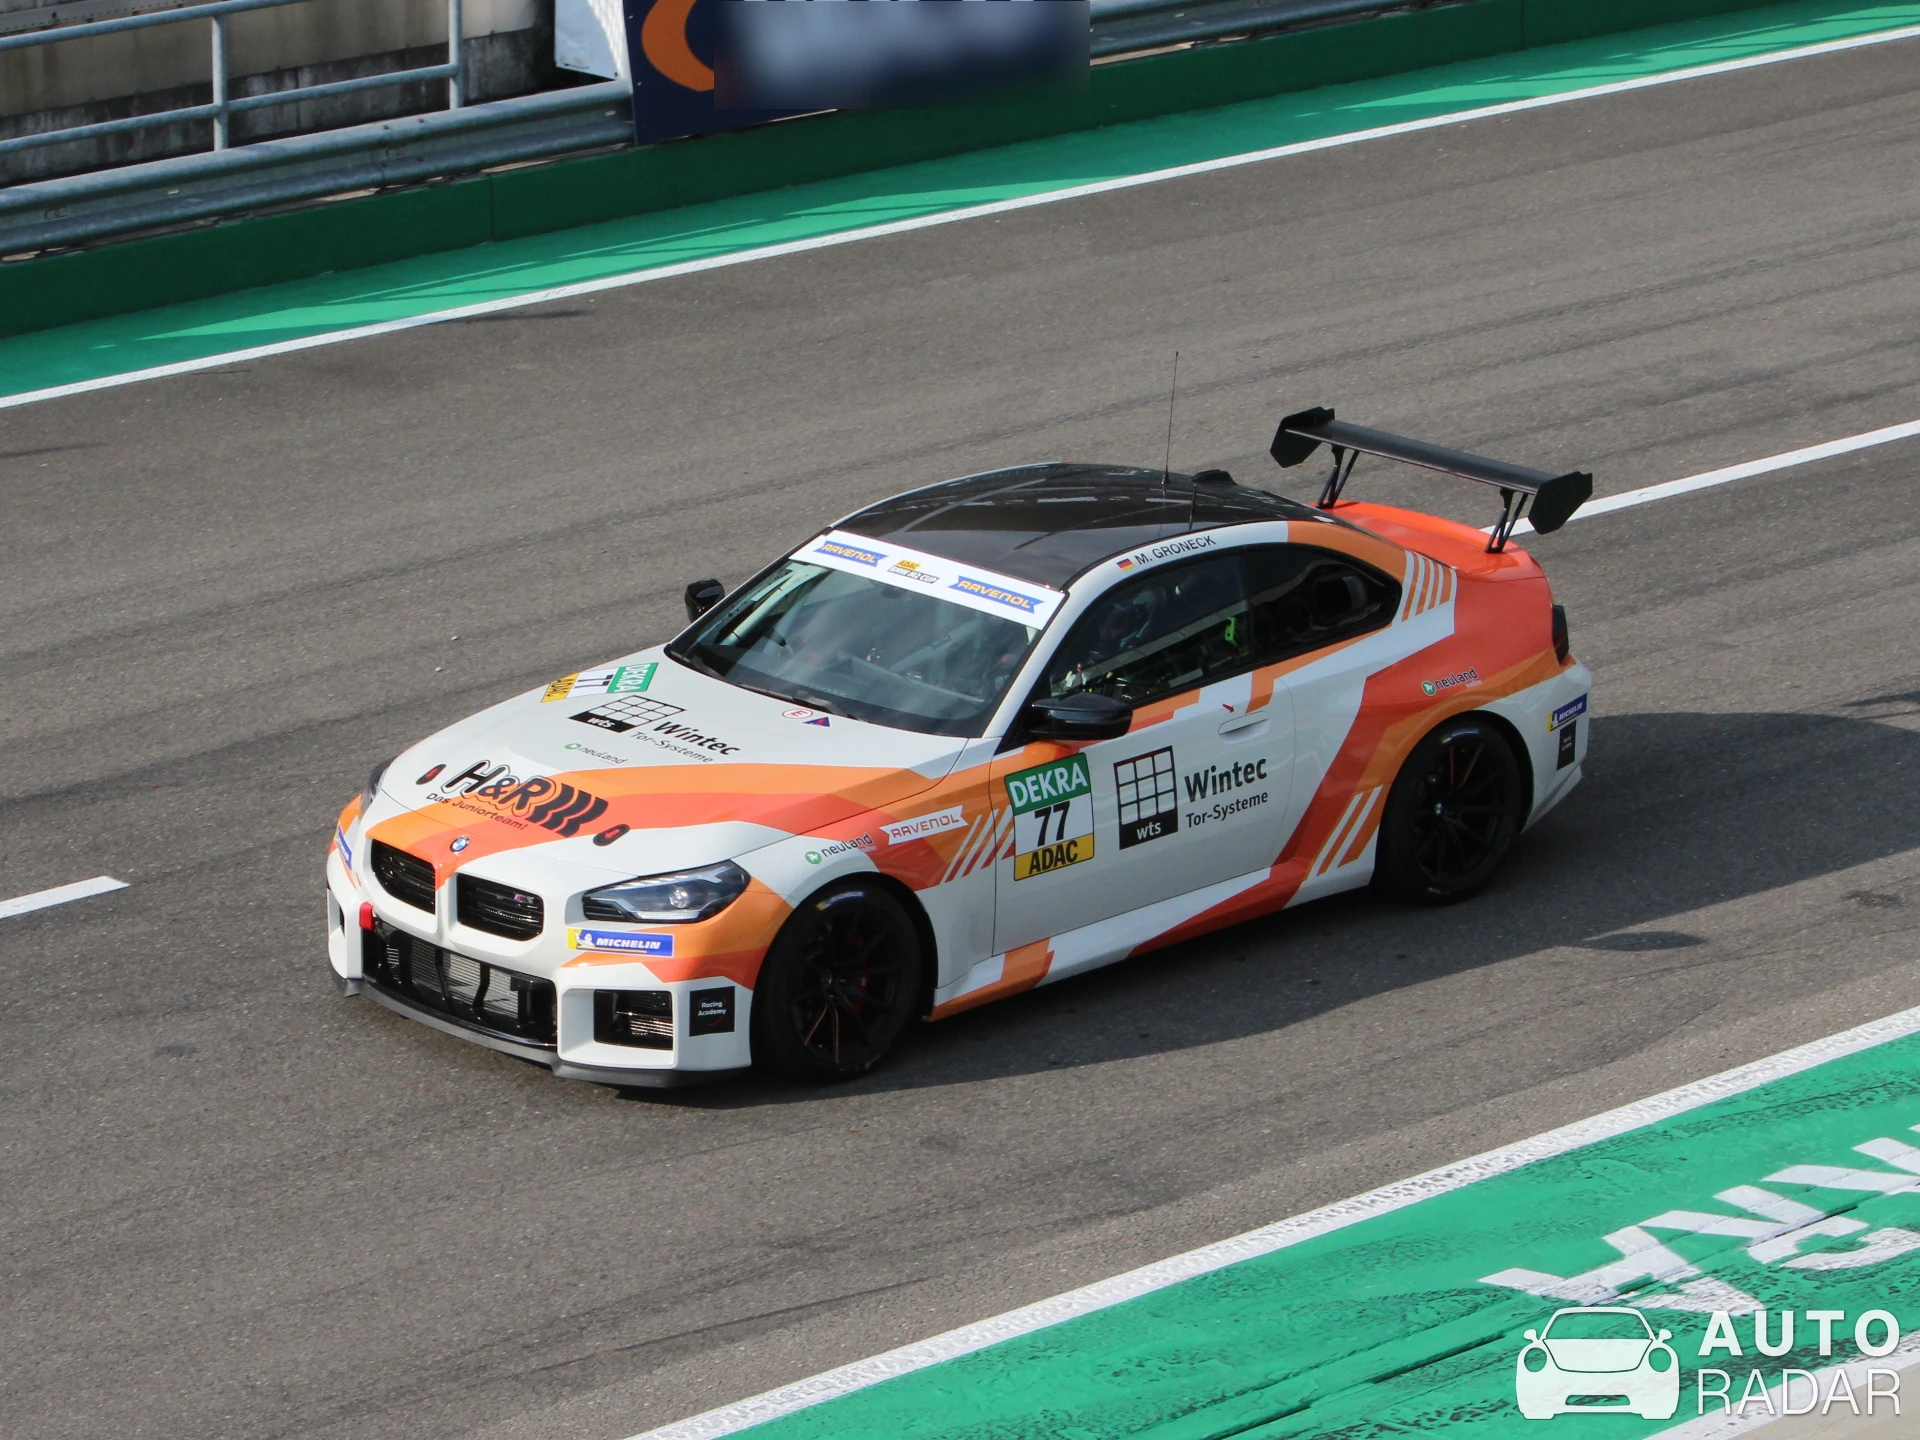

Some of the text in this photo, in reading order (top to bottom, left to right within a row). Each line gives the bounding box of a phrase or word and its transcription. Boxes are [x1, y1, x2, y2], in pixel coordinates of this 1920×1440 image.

[824, 543, 879, 564] RAVENOL
[1134, 535, 1217, 565] M. GRONECK
[888, 565, 911, 577] BMW
[919, 573, 938, 584] CUP
[899, 560, 920, 570] ADAC
[958, 579, 1030, 609] RAVENOL
[573, 674, 614, 689] 77
[614, 663, 651, 693] DEKRA
[1435, 667, 1478, 690] neuland
[587, 716, 615, 729] wts
[631, 731, 713, 764] Tor-Systeme
[652, 721, 740, 756] Wintec
[579, 745, 629, 765] neuland
[444, 760, 553, 812] H&R
[1008, 762, 1088, 808] DEKRA
[1184, 758, 1268, 803] Wintec
[426, 792, 451, 806] Das
[1185, 791, 1269, 828] Tor-Systeme
[452, 800, 529, 831] Juniorteam!
[890, 814, 960, 839] RAVENOL
[1034, 800, 1070, 847] 77
[1136, 821, 1162, 841] wts
[821, 833, 873, 858] neuland
[1028, 839, 1079, 875] ADAC
[596, 937, 662, 950] MICHELIN
[697, 1008, 727, 1017] Academy
[701, 1001, 723, 1009] Racing
